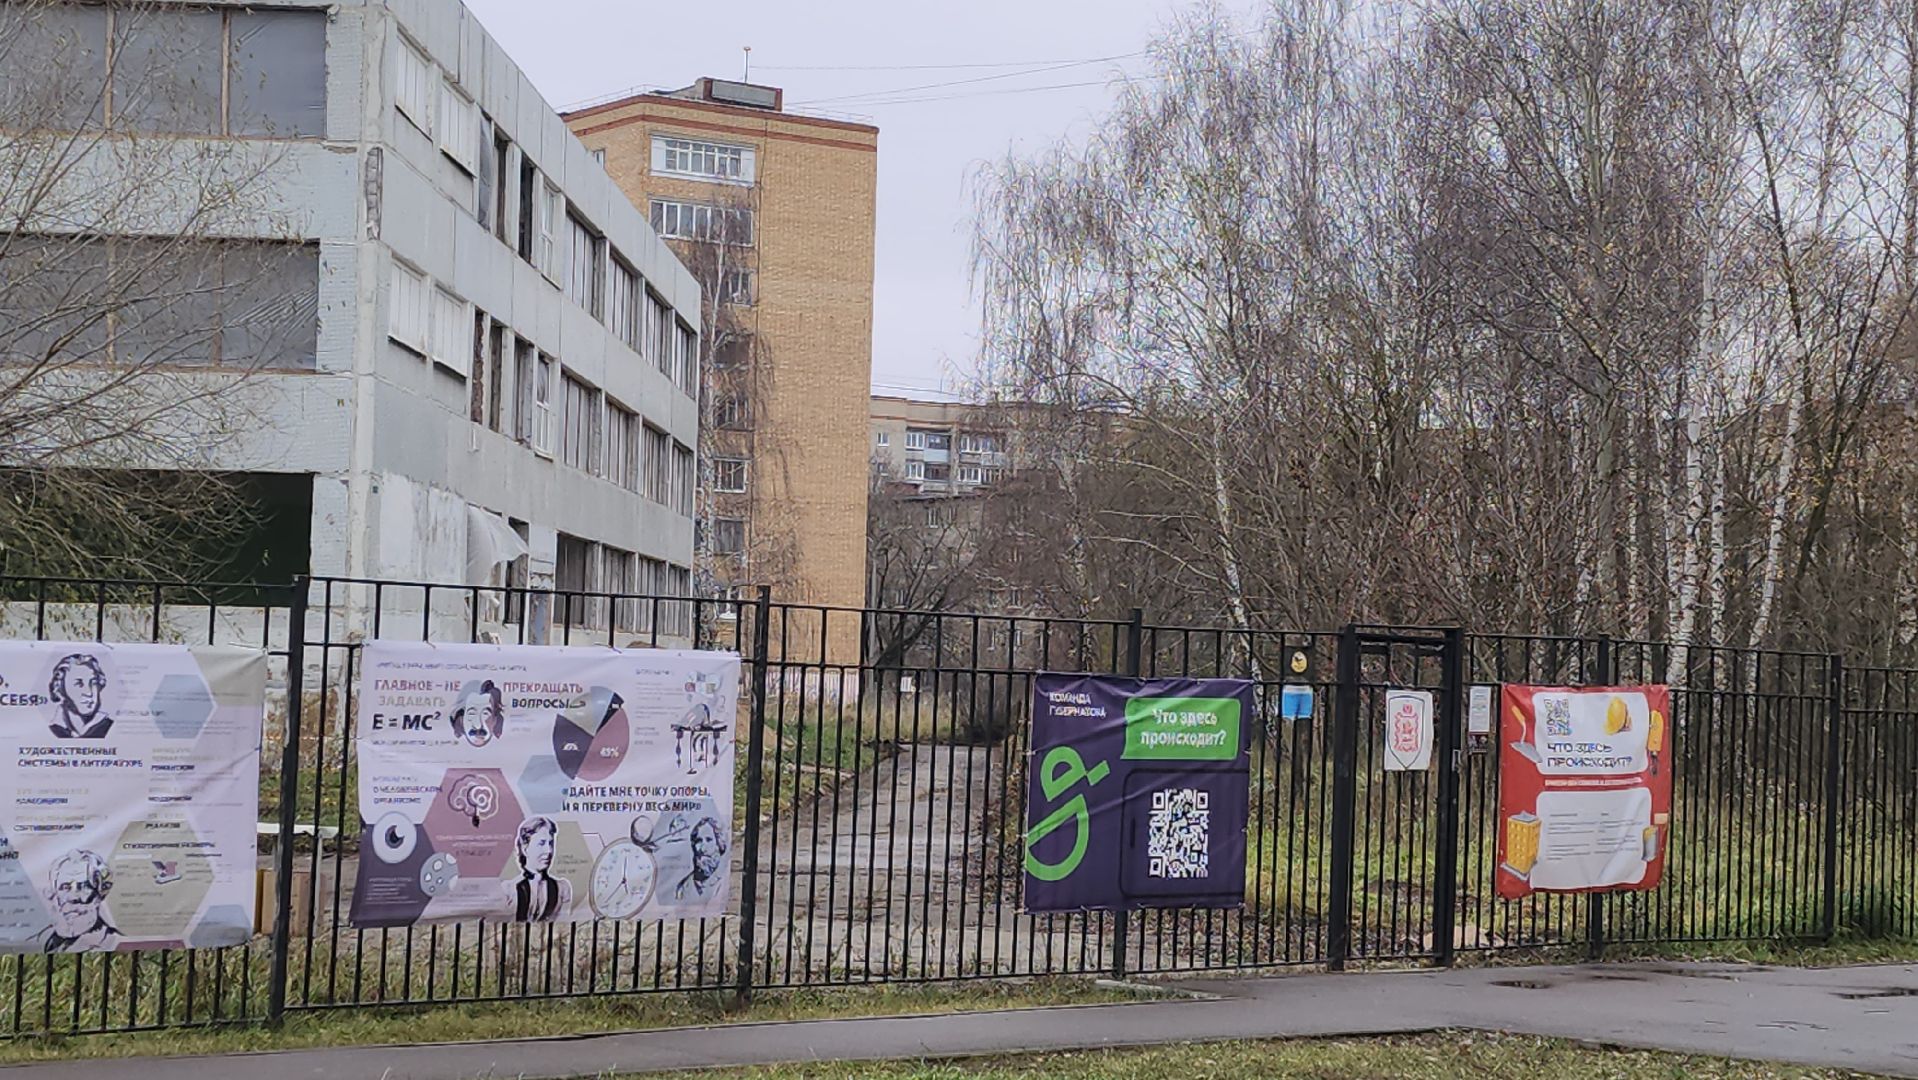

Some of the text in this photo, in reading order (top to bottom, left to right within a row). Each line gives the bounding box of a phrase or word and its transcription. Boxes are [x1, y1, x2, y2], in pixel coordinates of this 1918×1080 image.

[374, 680, 433, 691] ГЛАВНОЕ
[444, 681, 461, 691] НЕ
[503, 682, 583, 693] ПРЕКРАЩАТЬ
[378, 696, 569, 708] ЗАДАВАТЬ ВОПРОСЫ
[1153, 708, 1218, 726] Что здесь
[1140, 730, 1227, 749] происходит?
[1547, 743, 1613, 753] ЧТО ЗДЕСЬ
[1547, 756, 1632, 768] ПРОИСХОДИТ?
[609, 786, 633, 797] МНЕ
[635, 786, 668, 797] ТОЧКУ
[562, 801, 570, 812] И
[572, 801, 580, 812] Я
[582, 801, 644, 812] ПЕРЕВЕРНУ
[645, 801, 671, 812] ВЕСЬ
